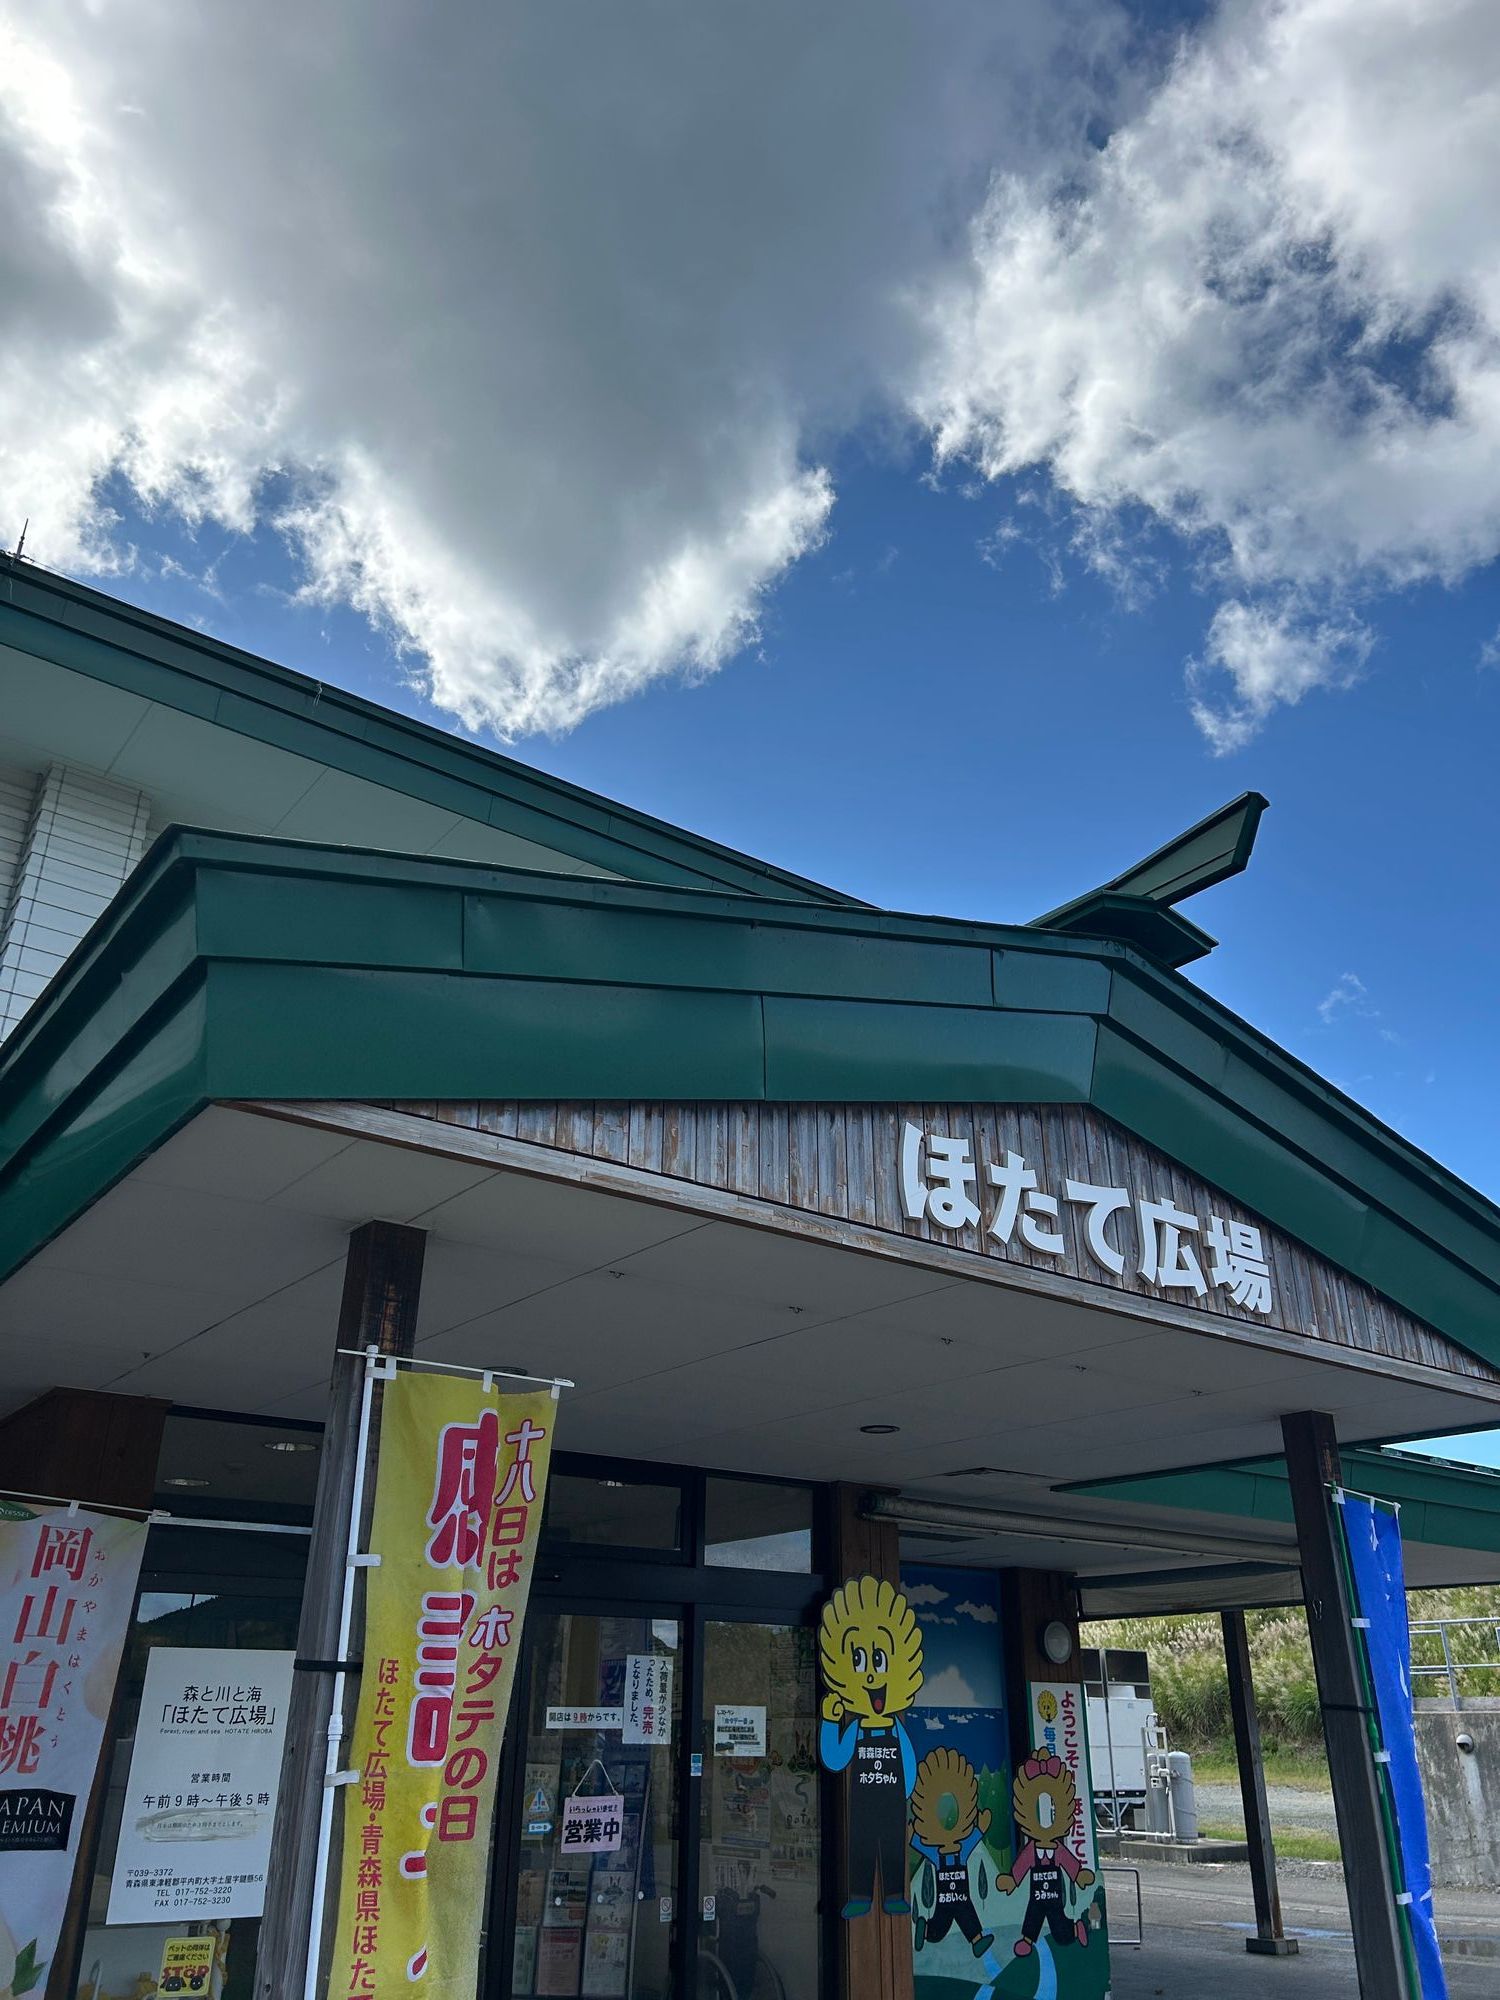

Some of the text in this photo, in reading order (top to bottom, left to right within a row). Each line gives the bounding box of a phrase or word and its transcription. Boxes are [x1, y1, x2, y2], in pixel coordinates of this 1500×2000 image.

[902, 1121, 1273, 1315] ほたて広場
[0, 1524, 95, 1774] 岡山白桃
[182, 1685, 262, 1702] 森と川と海
[629, 1659, 641, 1727] となりました。
[642, 1659, 656, 1735] ったため、完売
[657, 1660, 669, 1737] 入荷量が少なか
[162, 1704, 276, 1725] 「ほたて広場」
[437, 1604, 514, 1842] ホタテの日
[858, 1746, 898, 1760] 青森ほたて
[873, 1760, 883, 1771] の
[190, 1772, 232, 1784] 営業時間
[859, 1771, 898, 1785] ホタちゃん
[347, 1657, 401, 2000] ほたて広場・青森県ほた
[564, 1817, 620, 1845] 営業中
[938, 1871, 967, 1881] ほたて広場
[1033, 1871, 1058, 1881] ほたて広場
[156, 1886, 232, 1897] TEL 017-752-3220
[949, 1881, 956, 1890] の
[1043, 1881, 1050, 1890] の
[154, 1896, 231, 1908] FAX 017-752-3230
